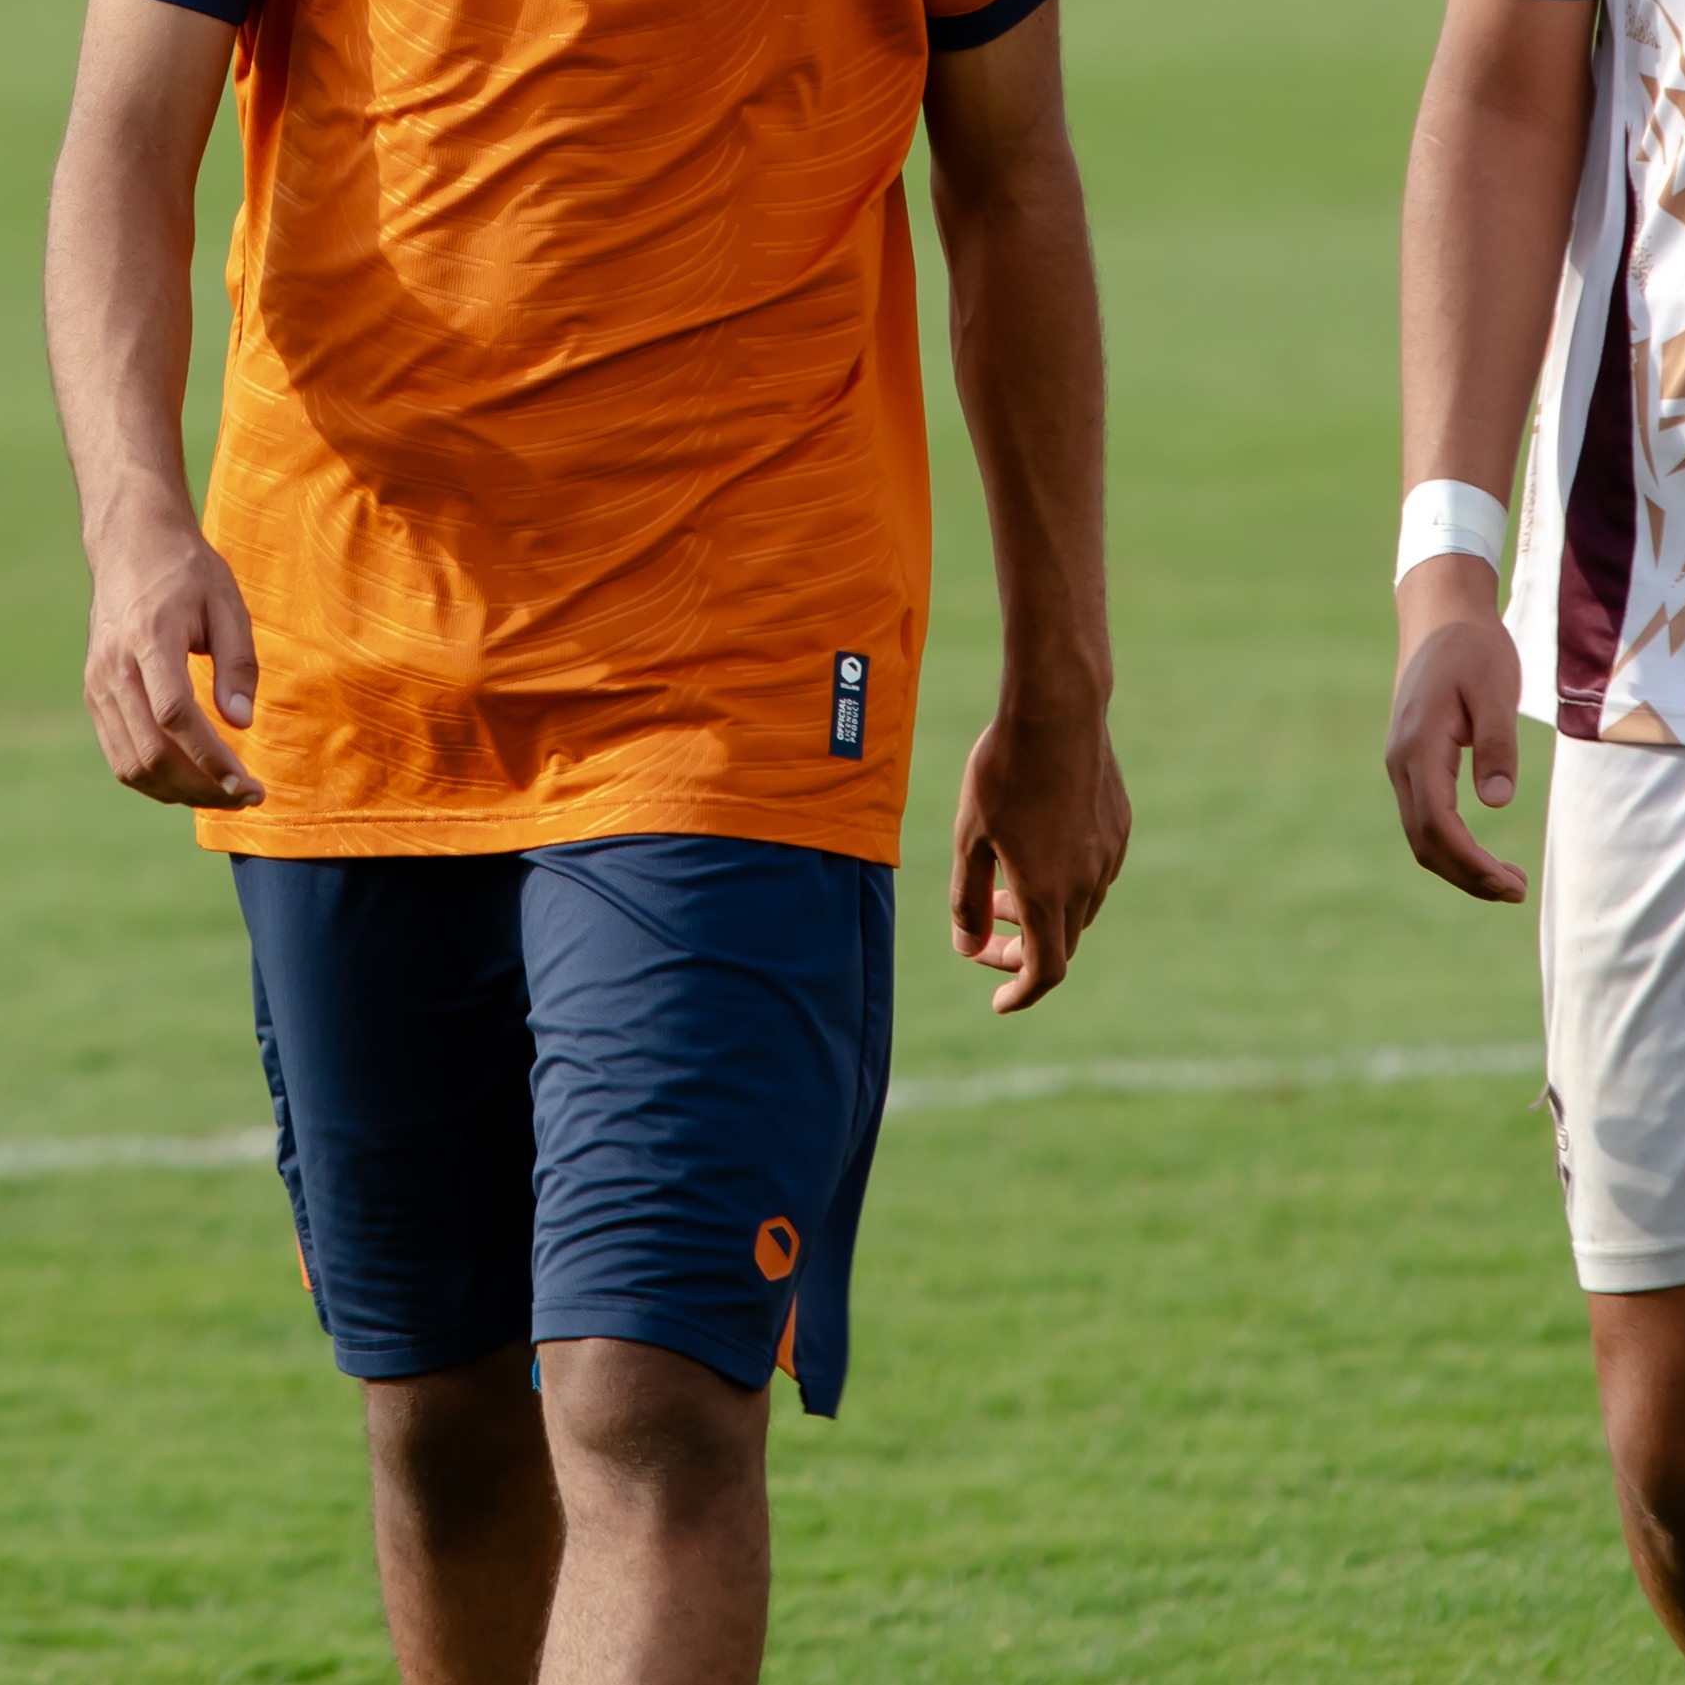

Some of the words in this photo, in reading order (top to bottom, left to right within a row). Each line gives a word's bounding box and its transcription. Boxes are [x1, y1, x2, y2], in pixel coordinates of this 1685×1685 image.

[836, 698, 847, 741] OFFICIAL
[844, 699, 853, 743] LICENSED
[850, 701, 860, 744] PRODUCT
